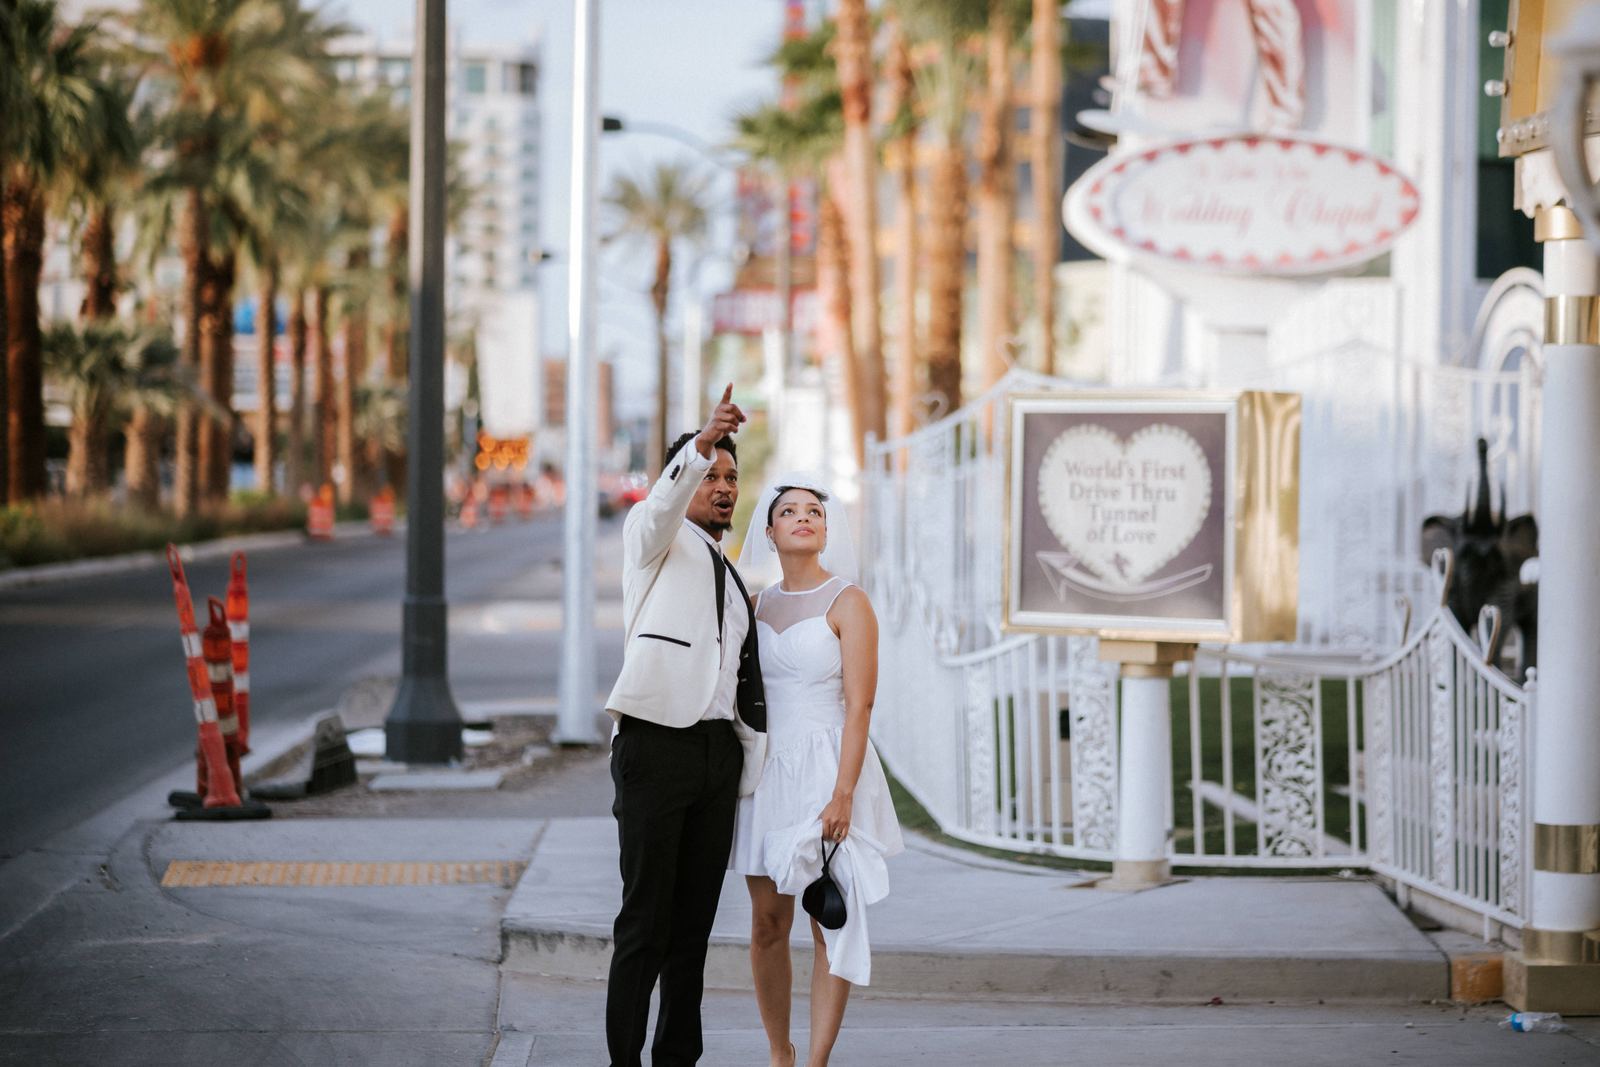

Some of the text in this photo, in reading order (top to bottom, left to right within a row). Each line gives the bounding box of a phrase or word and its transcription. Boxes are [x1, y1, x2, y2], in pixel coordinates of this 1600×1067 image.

[1064, 460, 1186, 480] World's First
[1069, 482, 1178, 503] Drive Thru
[1088, 504, 1158, 523] Tunnel
[1086, 525, 1158, 545] of Love
